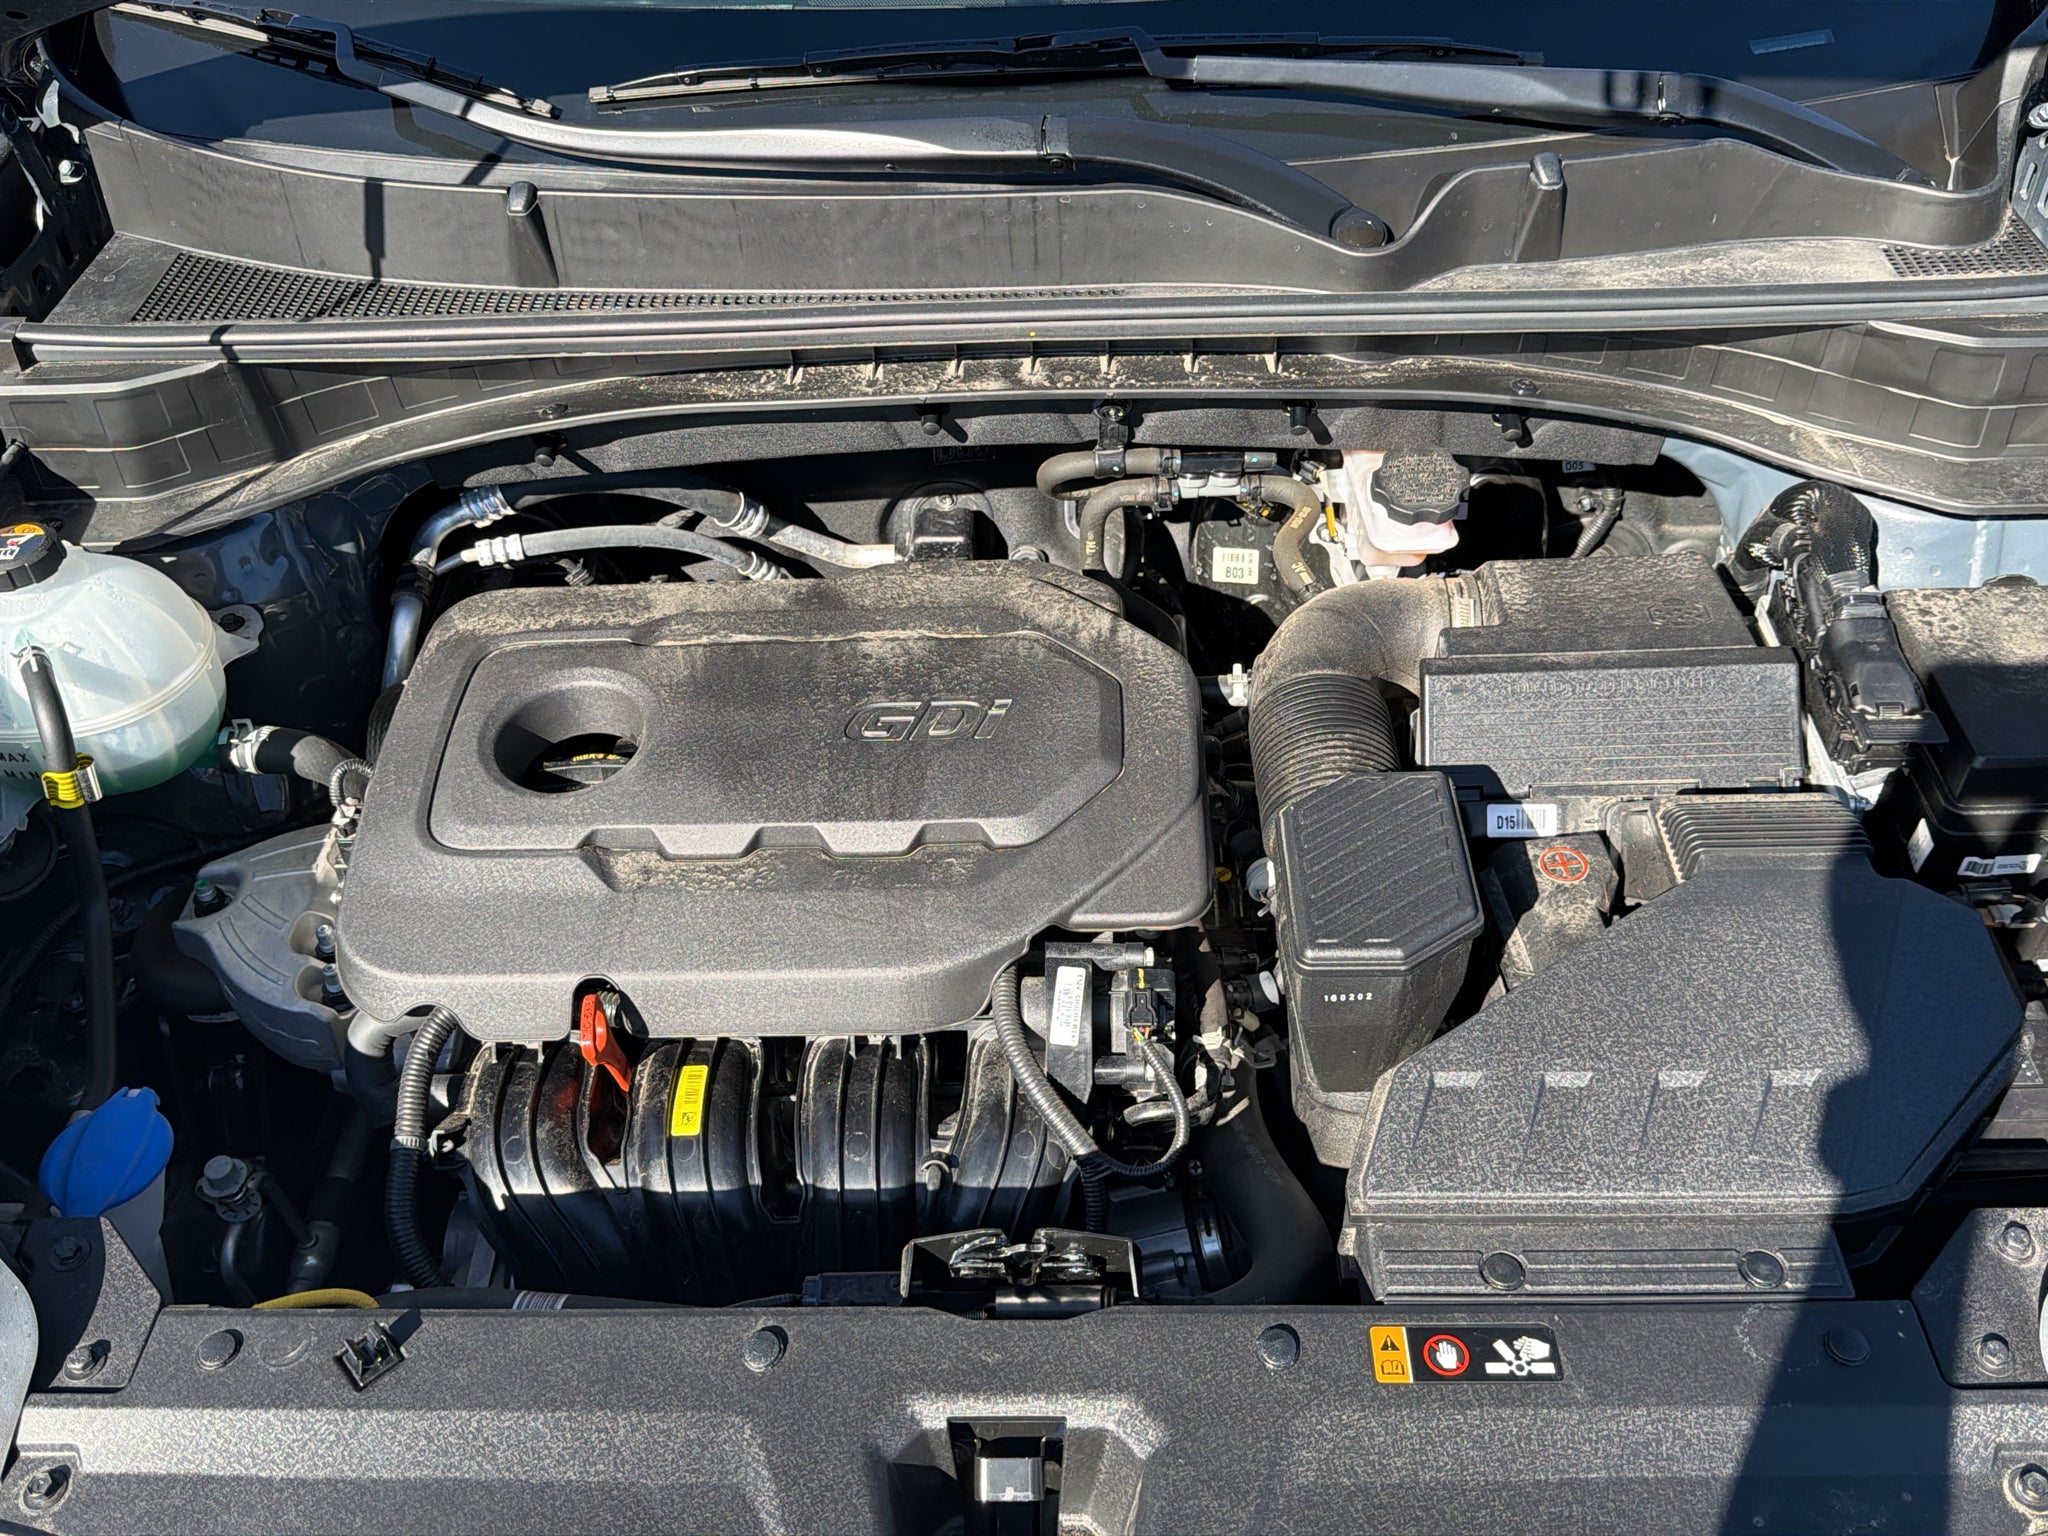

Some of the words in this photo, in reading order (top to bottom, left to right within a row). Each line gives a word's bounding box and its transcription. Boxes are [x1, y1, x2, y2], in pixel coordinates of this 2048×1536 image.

[844, 698, 1013, 742] GDi
[0, 752, 30, 763] MAX
[3, 769, 40, 780] MIN
[1497, 815, 1516, 830] D15
[1323, 992, 1373, 1002] 160202
